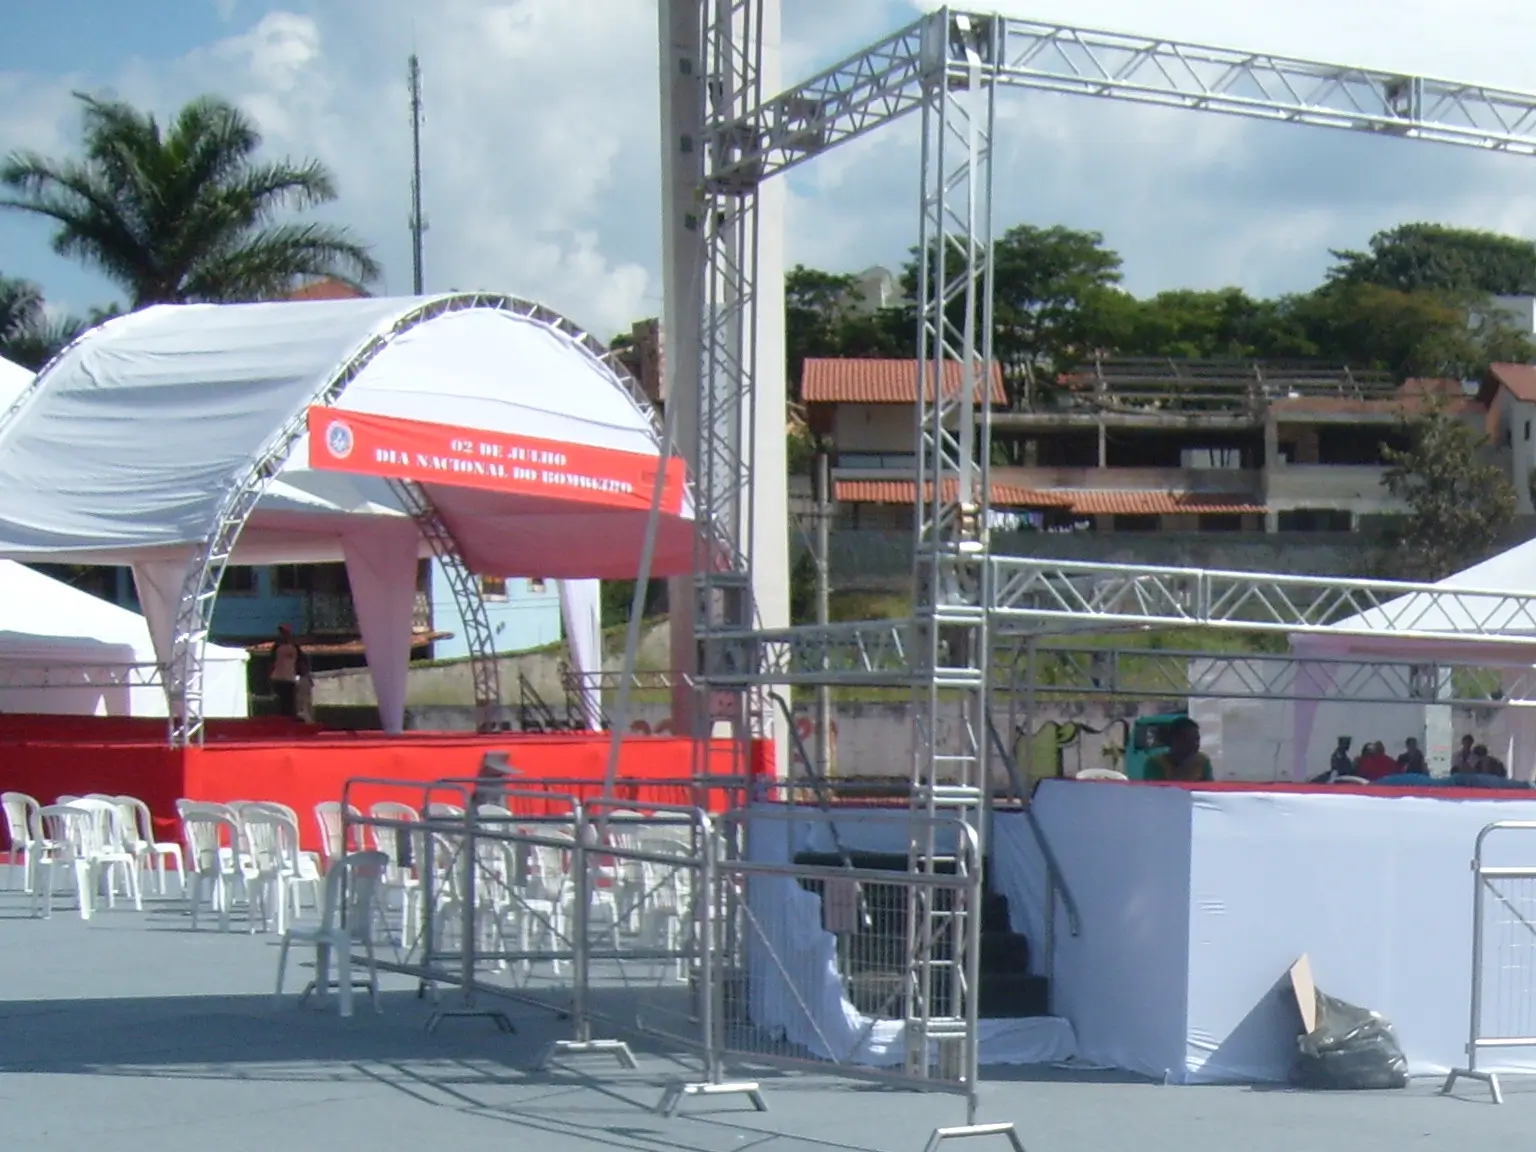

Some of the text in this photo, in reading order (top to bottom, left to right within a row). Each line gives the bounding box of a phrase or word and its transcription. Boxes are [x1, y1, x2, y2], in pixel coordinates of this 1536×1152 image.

[451, 439, 567, 466] 02 DE JULHO
[376, 448, 633, 494] DIA NACIONAL DO BOMBEIRO
